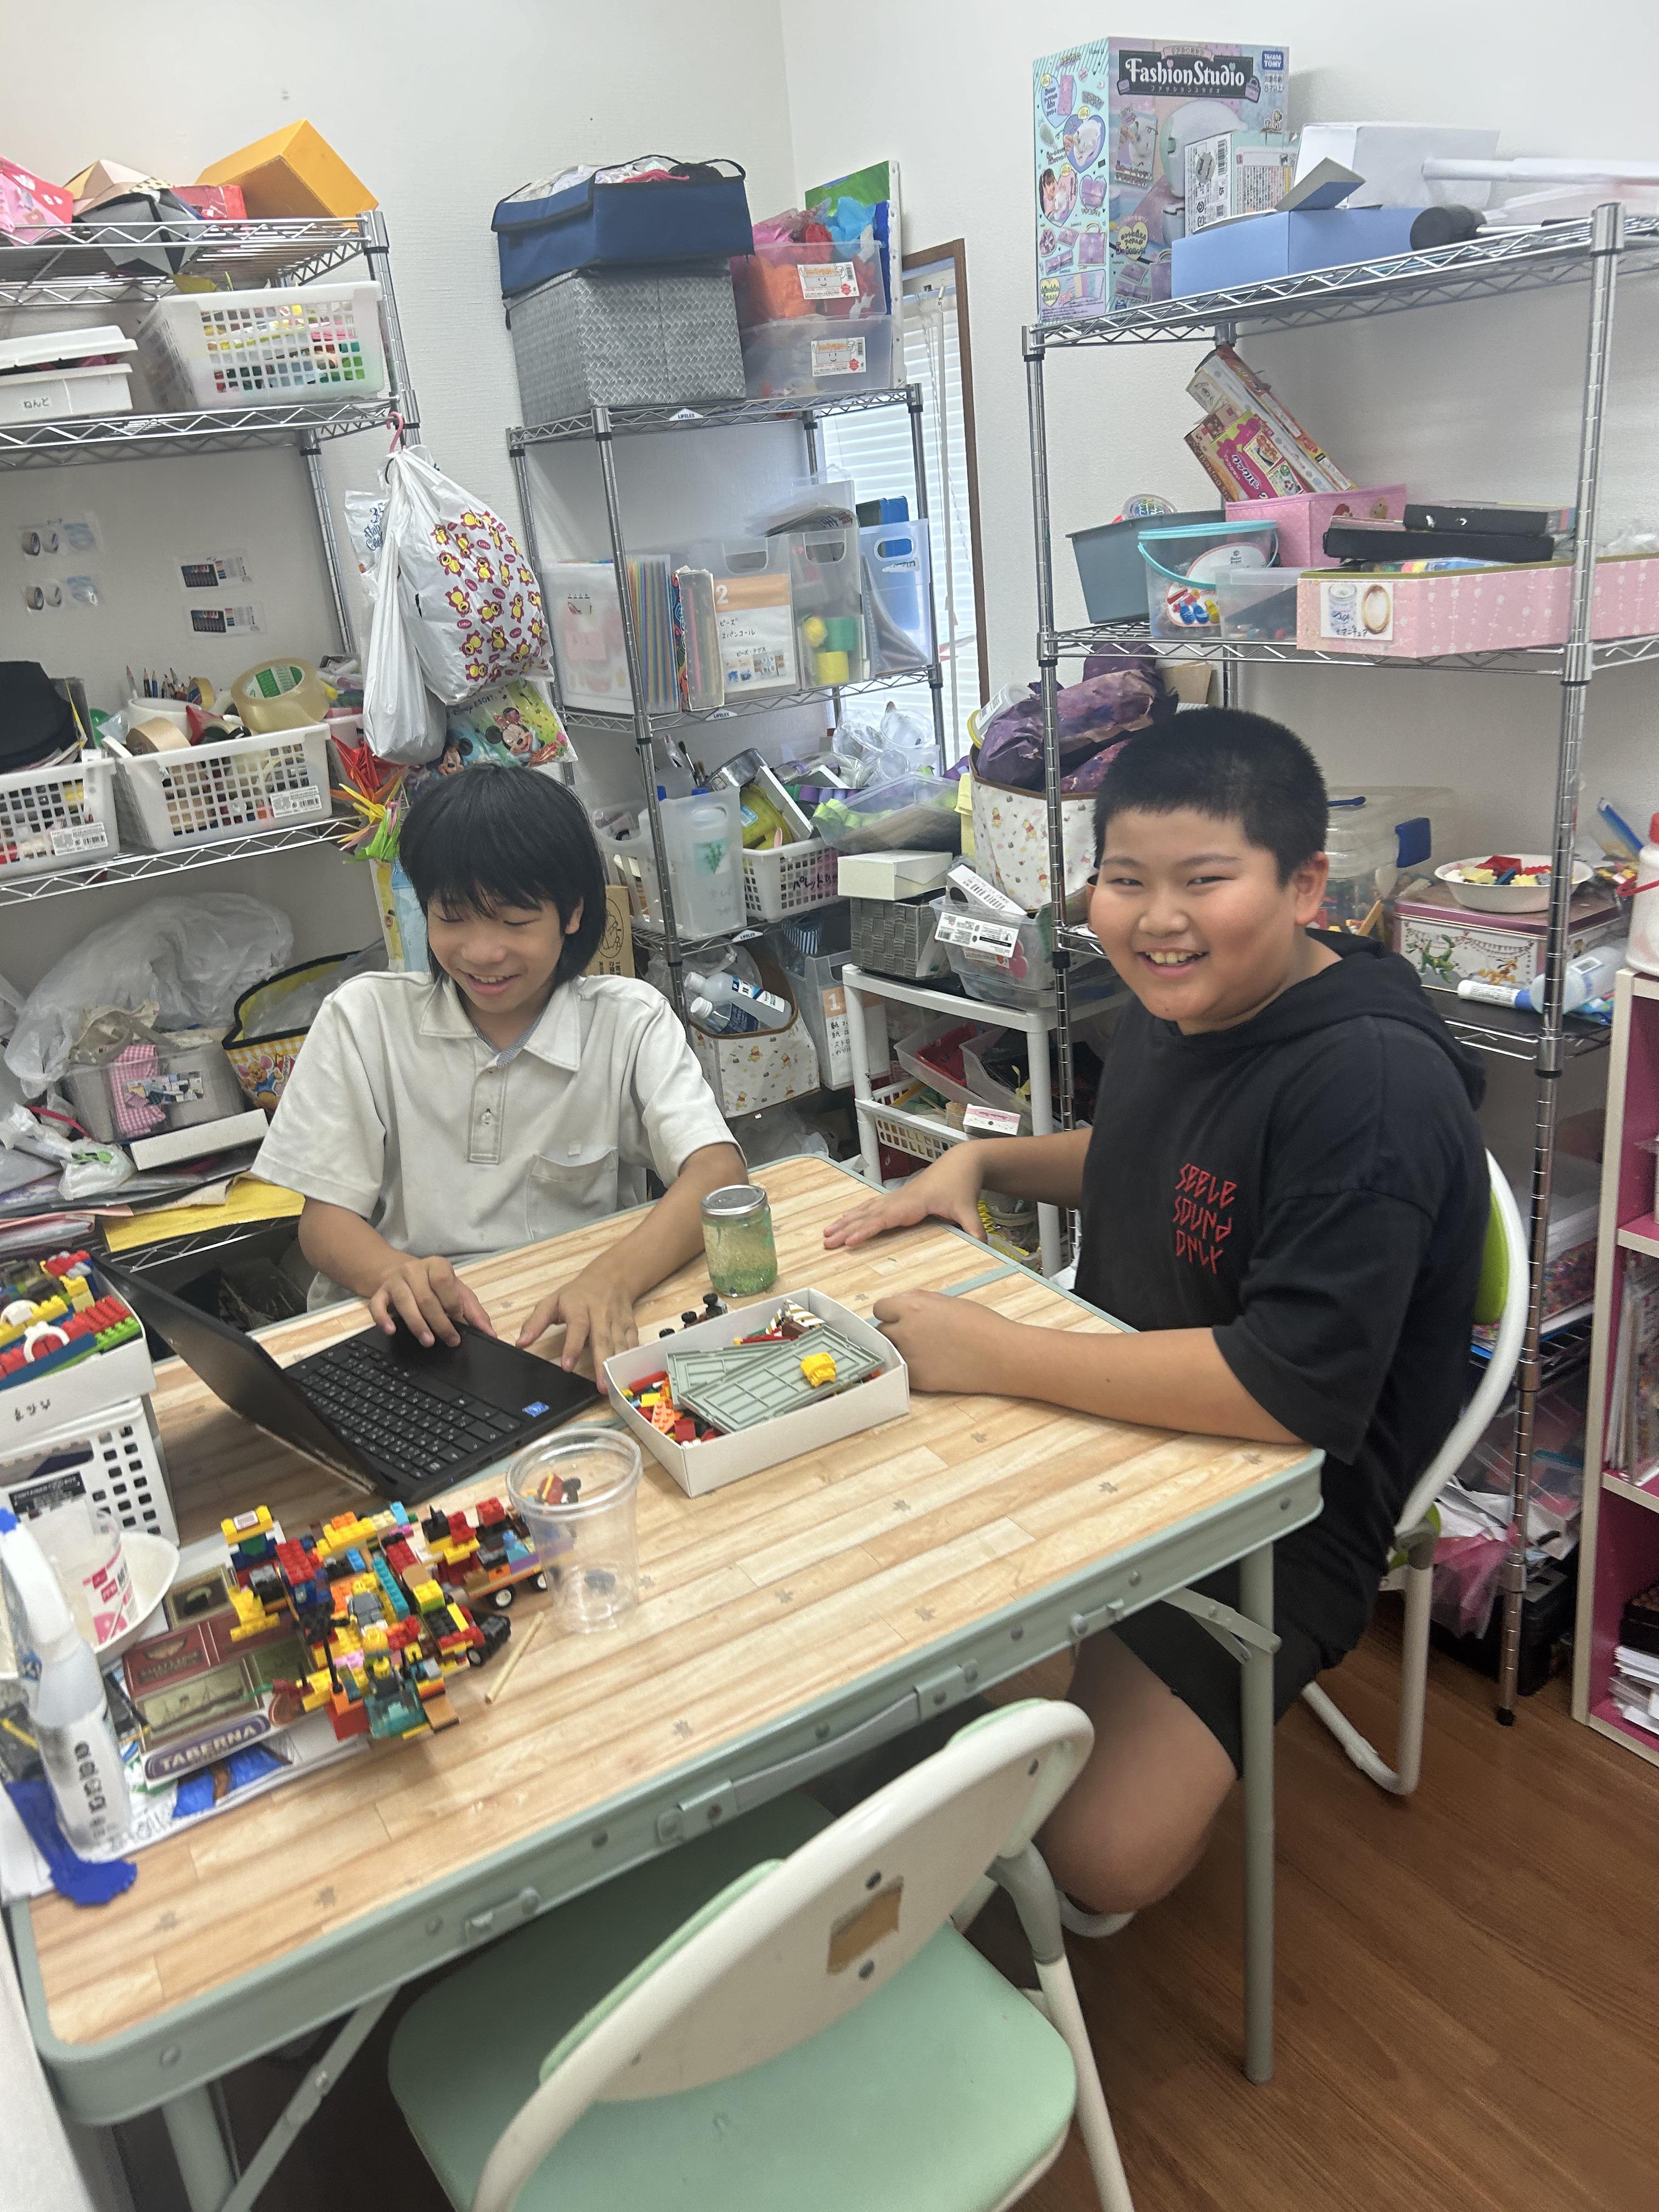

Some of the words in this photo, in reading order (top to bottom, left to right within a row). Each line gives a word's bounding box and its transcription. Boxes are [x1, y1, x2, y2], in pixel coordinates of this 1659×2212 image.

[716, 585, 729, 604] 2
[722, 629, 755, 639] スパンコール
[828, 994, 840, 1011] 1
[834, 1039, 850, 1048] ストロ
[160, 1725, 257, 1771] TABERNA
